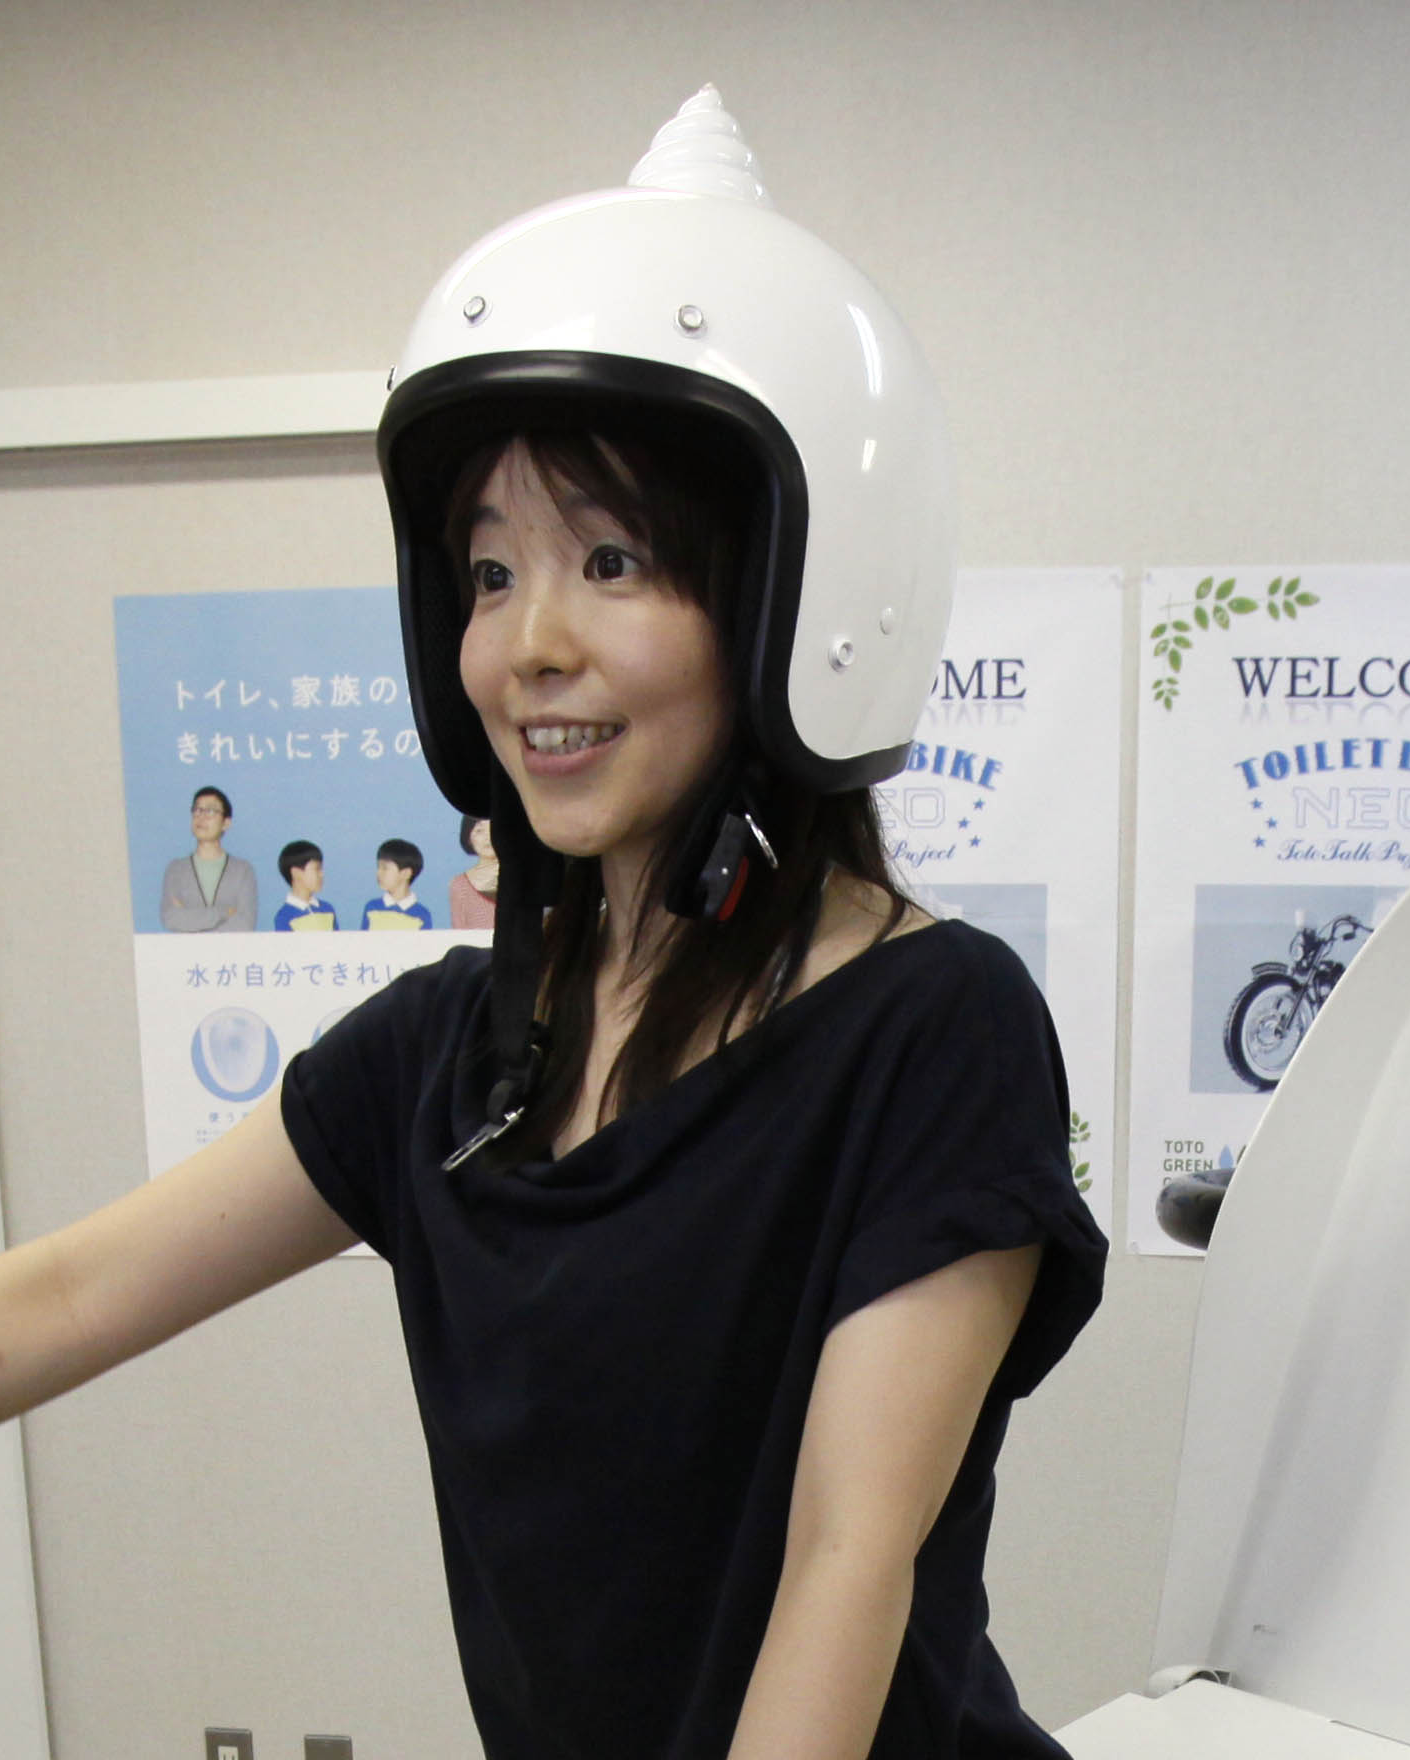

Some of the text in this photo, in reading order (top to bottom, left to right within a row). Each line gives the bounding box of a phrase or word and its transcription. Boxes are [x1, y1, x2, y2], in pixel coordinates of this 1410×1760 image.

[175, 674, 411, 711] トイレ、家族の
[931, 659, 1027, 700] ME
[176, 728, 421, 765] きれいにするの
[1234, 738, 1390, 790] TOILET
[906, 741, 1003, 791] BIKE
[1320, 839, 1371, 862] Talk
[1162, 1158, 1214, 1173] GREEN
[1163, 1140, 1205, 1154] TOTO
